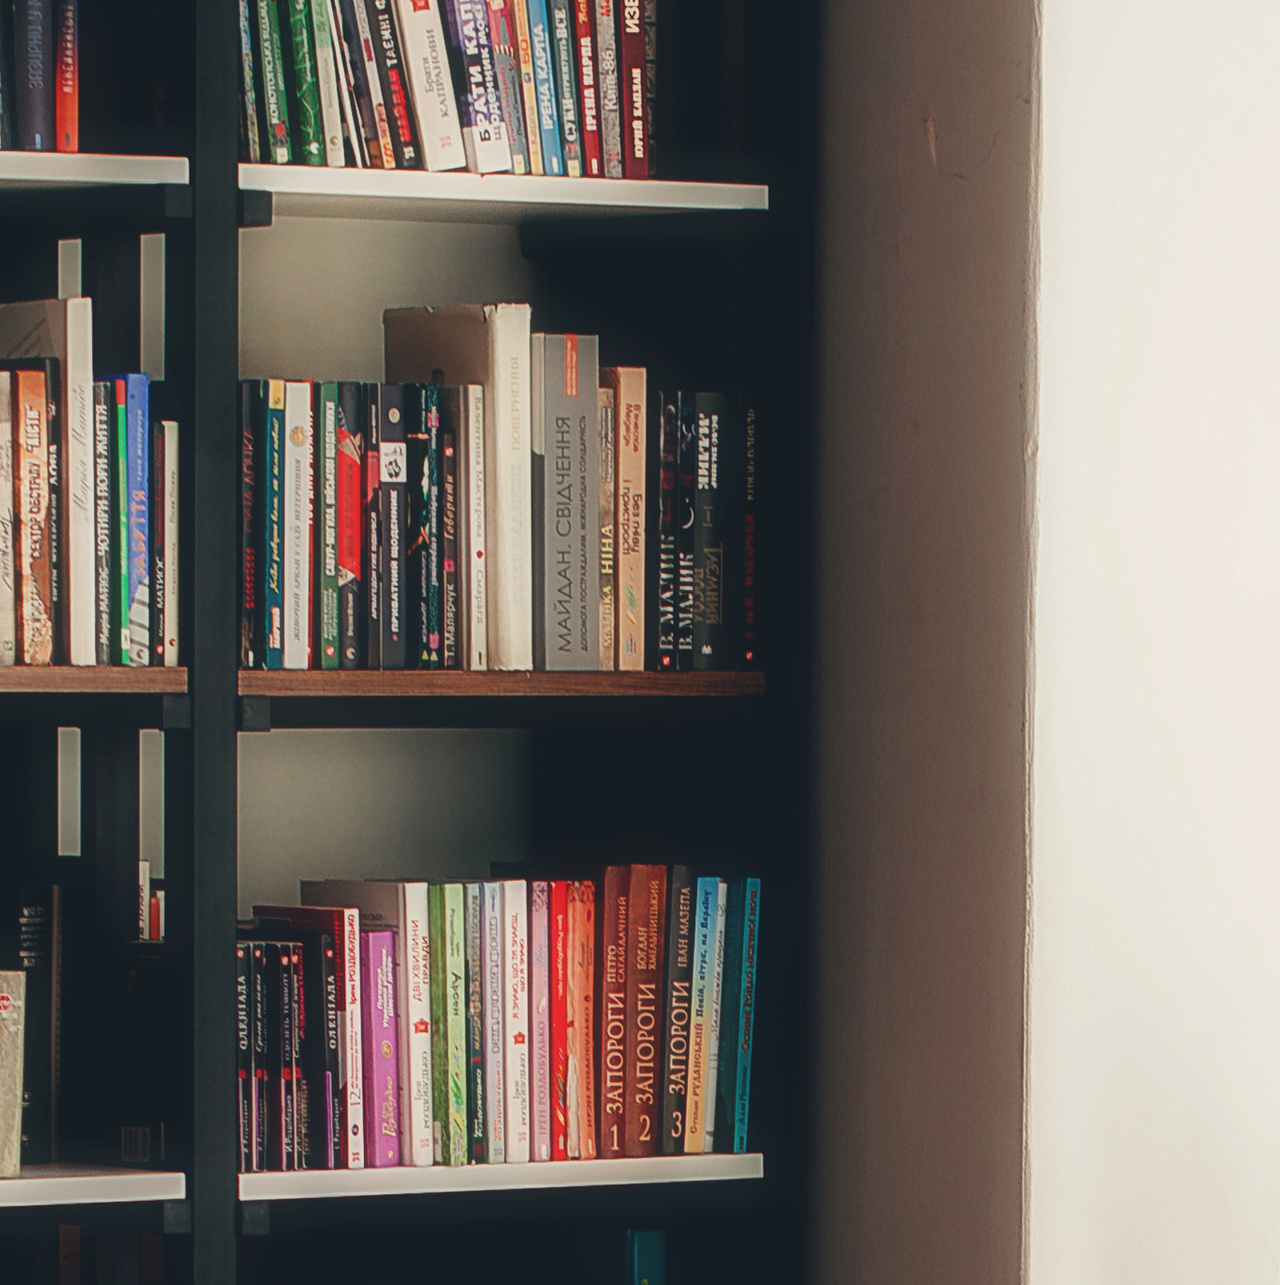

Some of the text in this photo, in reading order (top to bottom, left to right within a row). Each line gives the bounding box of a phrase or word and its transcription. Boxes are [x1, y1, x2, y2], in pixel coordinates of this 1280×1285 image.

[554, 7, 568, 39] ВСЕ
[422, 56, 435, 93] Брати
[426, 28, 450, 118] КАПРАНОВИ
[534, 22, 554, 130] ІРЕНА КАРПА
[580, 36, 594, 85] КАРПА
[600, 48, 618, 112] Київ-86
[468, 64, 492, 142] БРАТИ
[584, 87, 598, 131] ІРЕНА
[510, 355, 521, 451] ПОВЕРНЕННЯ
[96, 458, 109, 496] ПОРИ
[475, 396, 485, 538] Валентина Мастерова
[555, 415, 572, 537] СВІДЧЕННЯ
[444, 473, 455, 541] Говорити
[631, 493, 643, 554] Без гніву
[389, 489, 400, 633] ПРИВАТНИЙ ЩОДЕННИК
[601, 522, 613, 575] НІНА
[660, 534, 675, 624] МАЛИК
[445, 582, 457, 646] Малярчук
[476, 568, 485, 624] Смарагд
[553, 543, 573, 653] МАЙДАН.
[679, 551, 694, 629] МАЛИК
[580, 603, 589, 652] ДОПОМОГА
[347, 913, 356, 982] РОЗДОБУДЬКО
[411, 919, 421, 980] ХВИЛИНИ
[421, 935, 430, 985] ПРАВДИ
[635, 926, 648, 971] БОГДАН
[647, 880, 660, 972] ХМЕЛЬНИЦЬКИЙ
[677, 886, 692, 969] ІВАН МАЗЕПА
[451, 971, 462, 1017] Арсен
[605, 944, 618, 984] ПЕТРО
[536, 1020, 548, 1107] РОЗДОБУДЬКО
[605, 992, 627, 1152] 1 ЗАПОРОГИ
[636, 982, 657, 1142] 2 ЗАПОРОГИ
[669, 980, 690, 1139] 3 ЗАПОРОГИ
[692, 1023, 704, 1097] РУДАНСЬКИЙ
